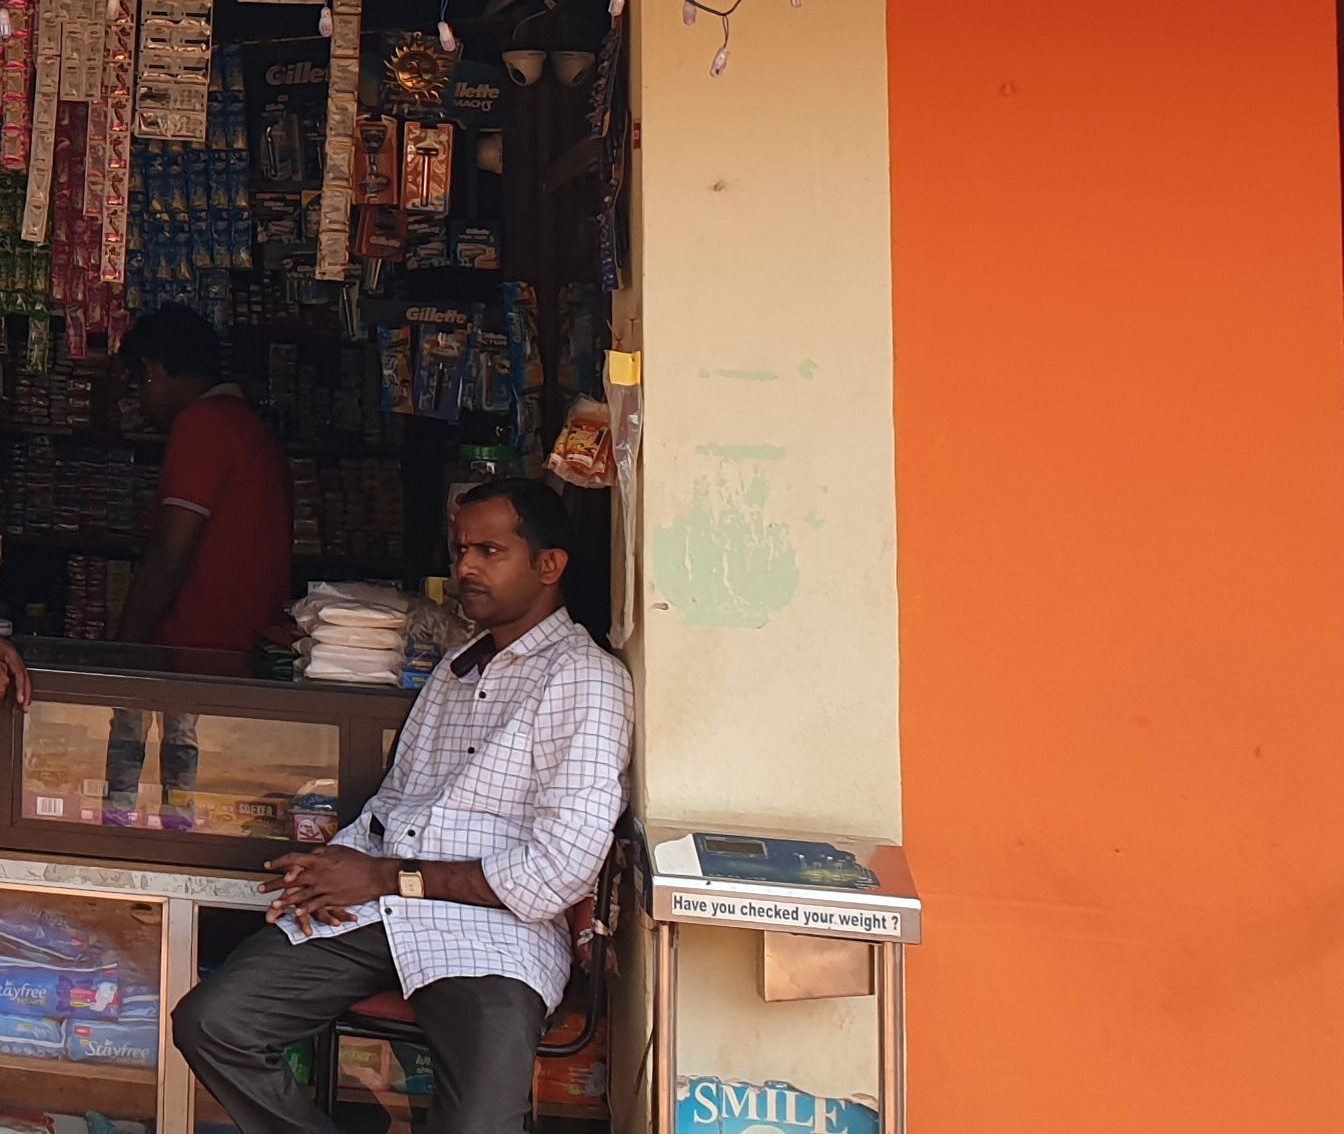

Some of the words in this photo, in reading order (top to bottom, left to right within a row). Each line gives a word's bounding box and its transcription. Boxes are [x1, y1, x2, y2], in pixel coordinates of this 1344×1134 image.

[405, 306, 467, 324] Gillette
[673, 894, 708, 913] Have
[711, 900, 737, 916] you
[740, 901, 800, 922] checked
[803, 909, 834, 926] your
[837, 913, 887, 932] weight
[86, 1038, 150, 1060] Stayfree
[692, 1081, 850, 1134] SMILE
